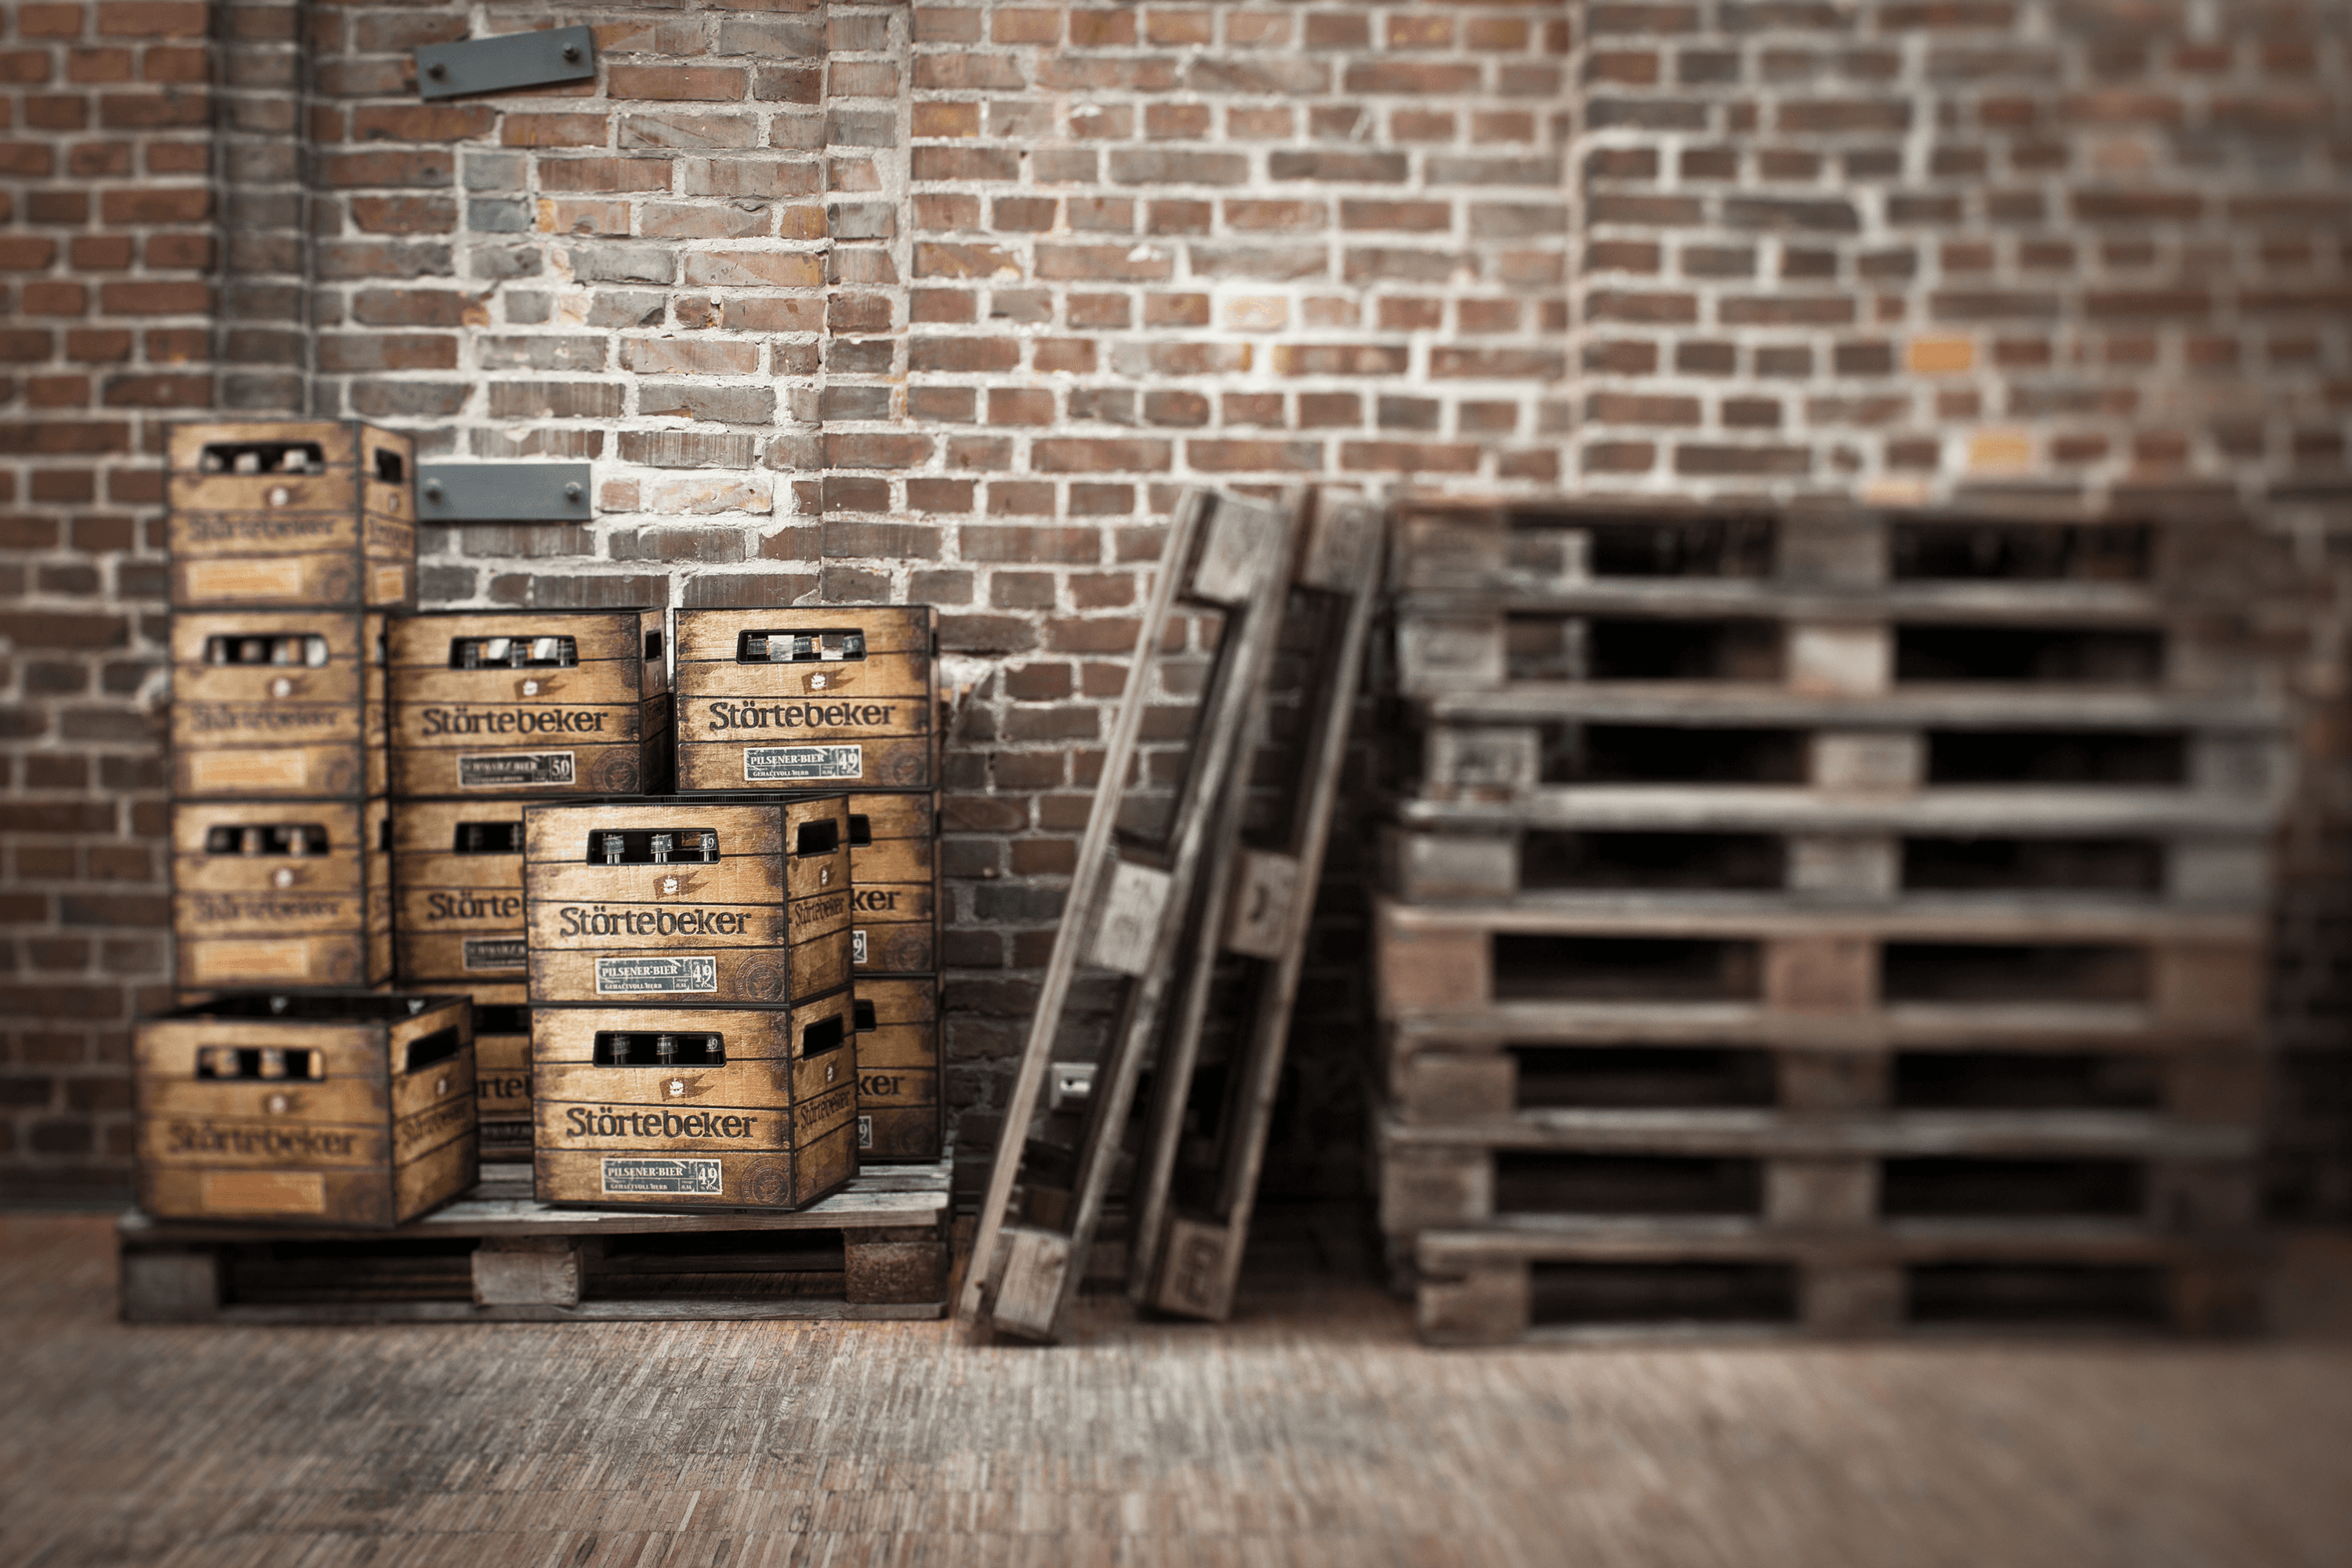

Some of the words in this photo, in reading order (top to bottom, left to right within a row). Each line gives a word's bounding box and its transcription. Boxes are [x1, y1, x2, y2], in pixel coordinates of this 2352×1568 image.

[422, 707, 608, 735] Störtebeker
[710, 700, 895, 731] Störtebeker
[750, 753, 825, 765] PILSENER-BIER
[426, 889, 520, 921] Störte
[851, 888, 901, 911] ker
[560, 906, 752, 937] Störtebeker
[602, 965, 678, 977] PILSENER-BIER
[858, 1073, 906, 1097] ker
[566, 1106, 758, 1138] Störtebeker
[608, 1167, 684, 1176] PILSENER-BIER
